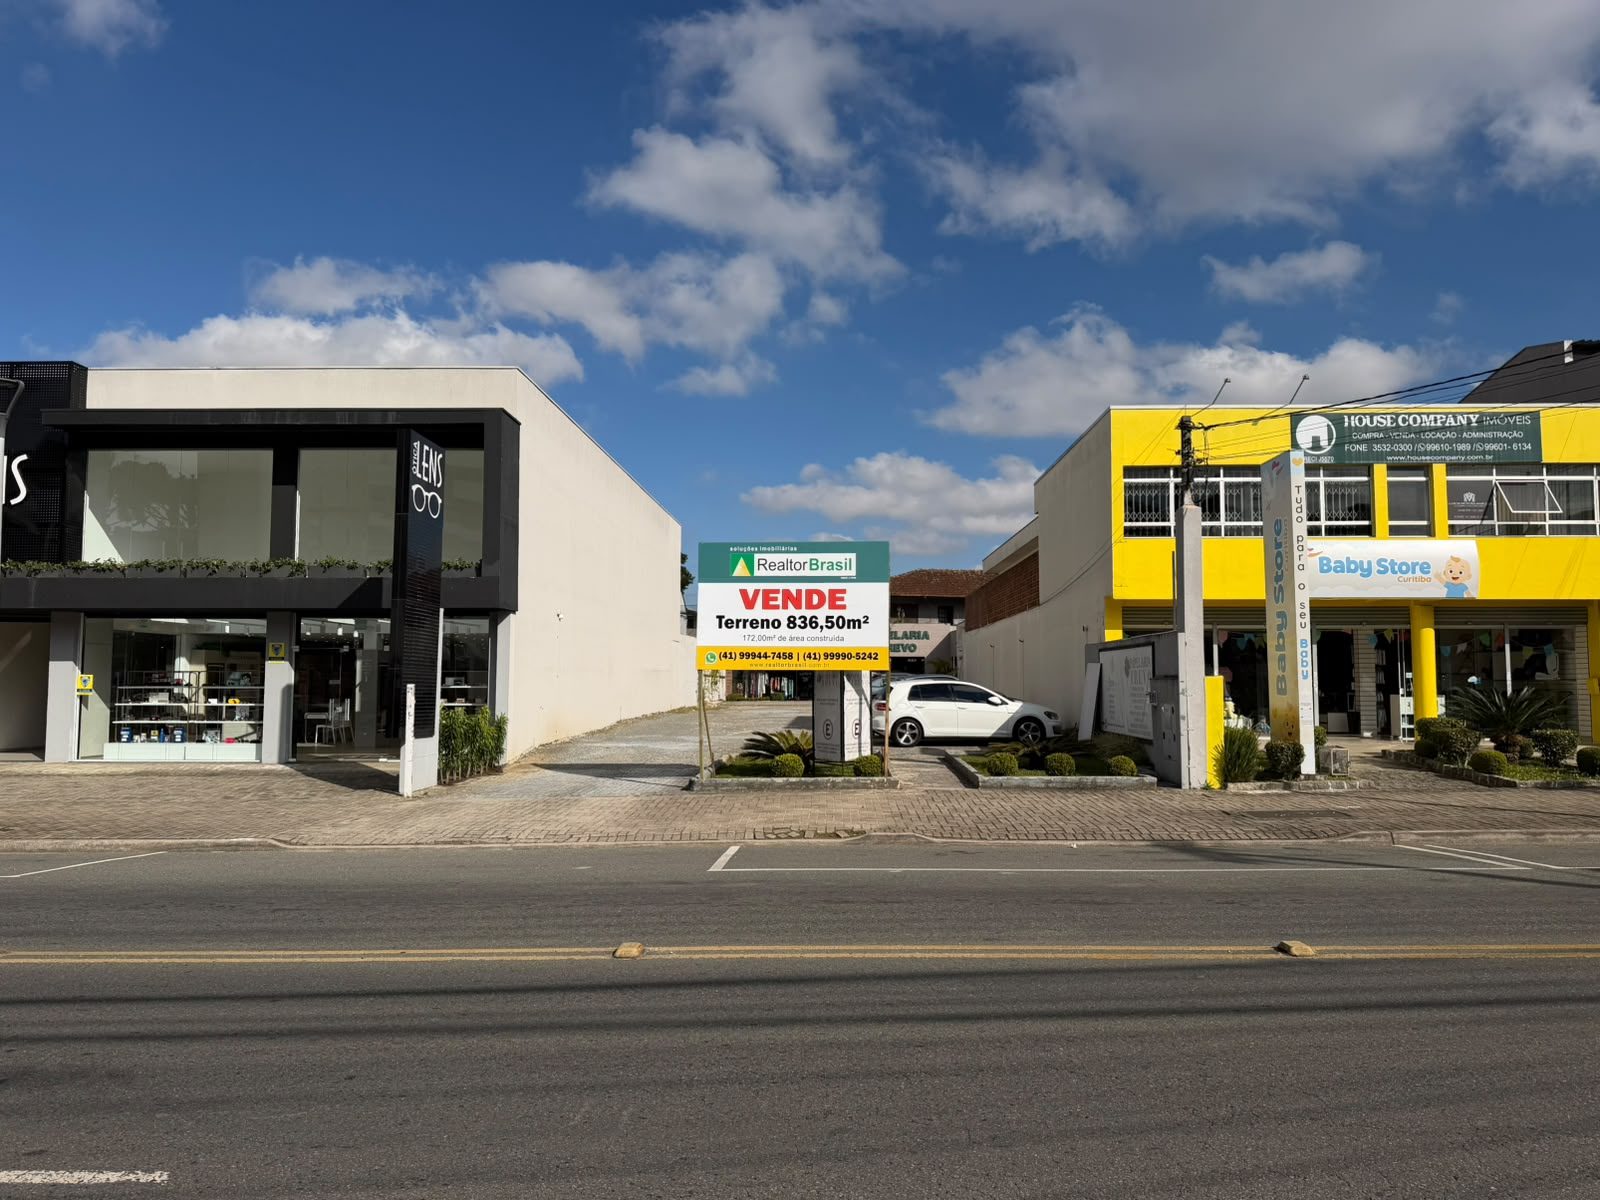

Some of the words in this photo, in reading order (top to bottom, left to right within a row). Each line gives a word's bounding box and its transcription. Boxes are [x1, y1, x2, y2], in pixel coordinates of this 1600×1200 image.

[1344, 414, 1396, 427] HOUSE
[1398, 414, 1479, 427] COMPANY
[1483, 413, 1531, 425] IMÓVEIS
[1352, 432, 1384, 440] COMPRA
[1421, 431, 1457, 440] LOCAÇÃO
[1462, 431, 1524, 439] ADMINISTRAÇÃO
[1345, 444, 1368, 452] FONE
[1372, 443, 1413, 452] 3532-0300
[416, 440, 443, 488] LENS
[1295, 485, 1304, 523] Tudo
[1274, 518, 1285, 605] Store
[1296, 535, 1305, 571] para
[757, 558, 852, 571] RealtorBrasil
[1318, 556, 1373, 578] Baby
[1376, 557, 1432, 575] Store
[1298, 583, 1305, 591] o
[739, 588, 847, 610] VENDE
[715, 615, 782, 629] Terreno
[786, 615, 869, 633] 836,50m²
[1299, 602, 1307, 629] seu
[743, 634, 776, 642] 172,00m²
[718, 651, 737, 661] (41)
[738, 651, 793, 660] 99944-7458
[803, 652, 821, 662] (41)
[823, 652, 879, 661] 99990-5242
[1275, 610, 1288, 696] Baby
[1299, 638, 1309, 680] Baby
